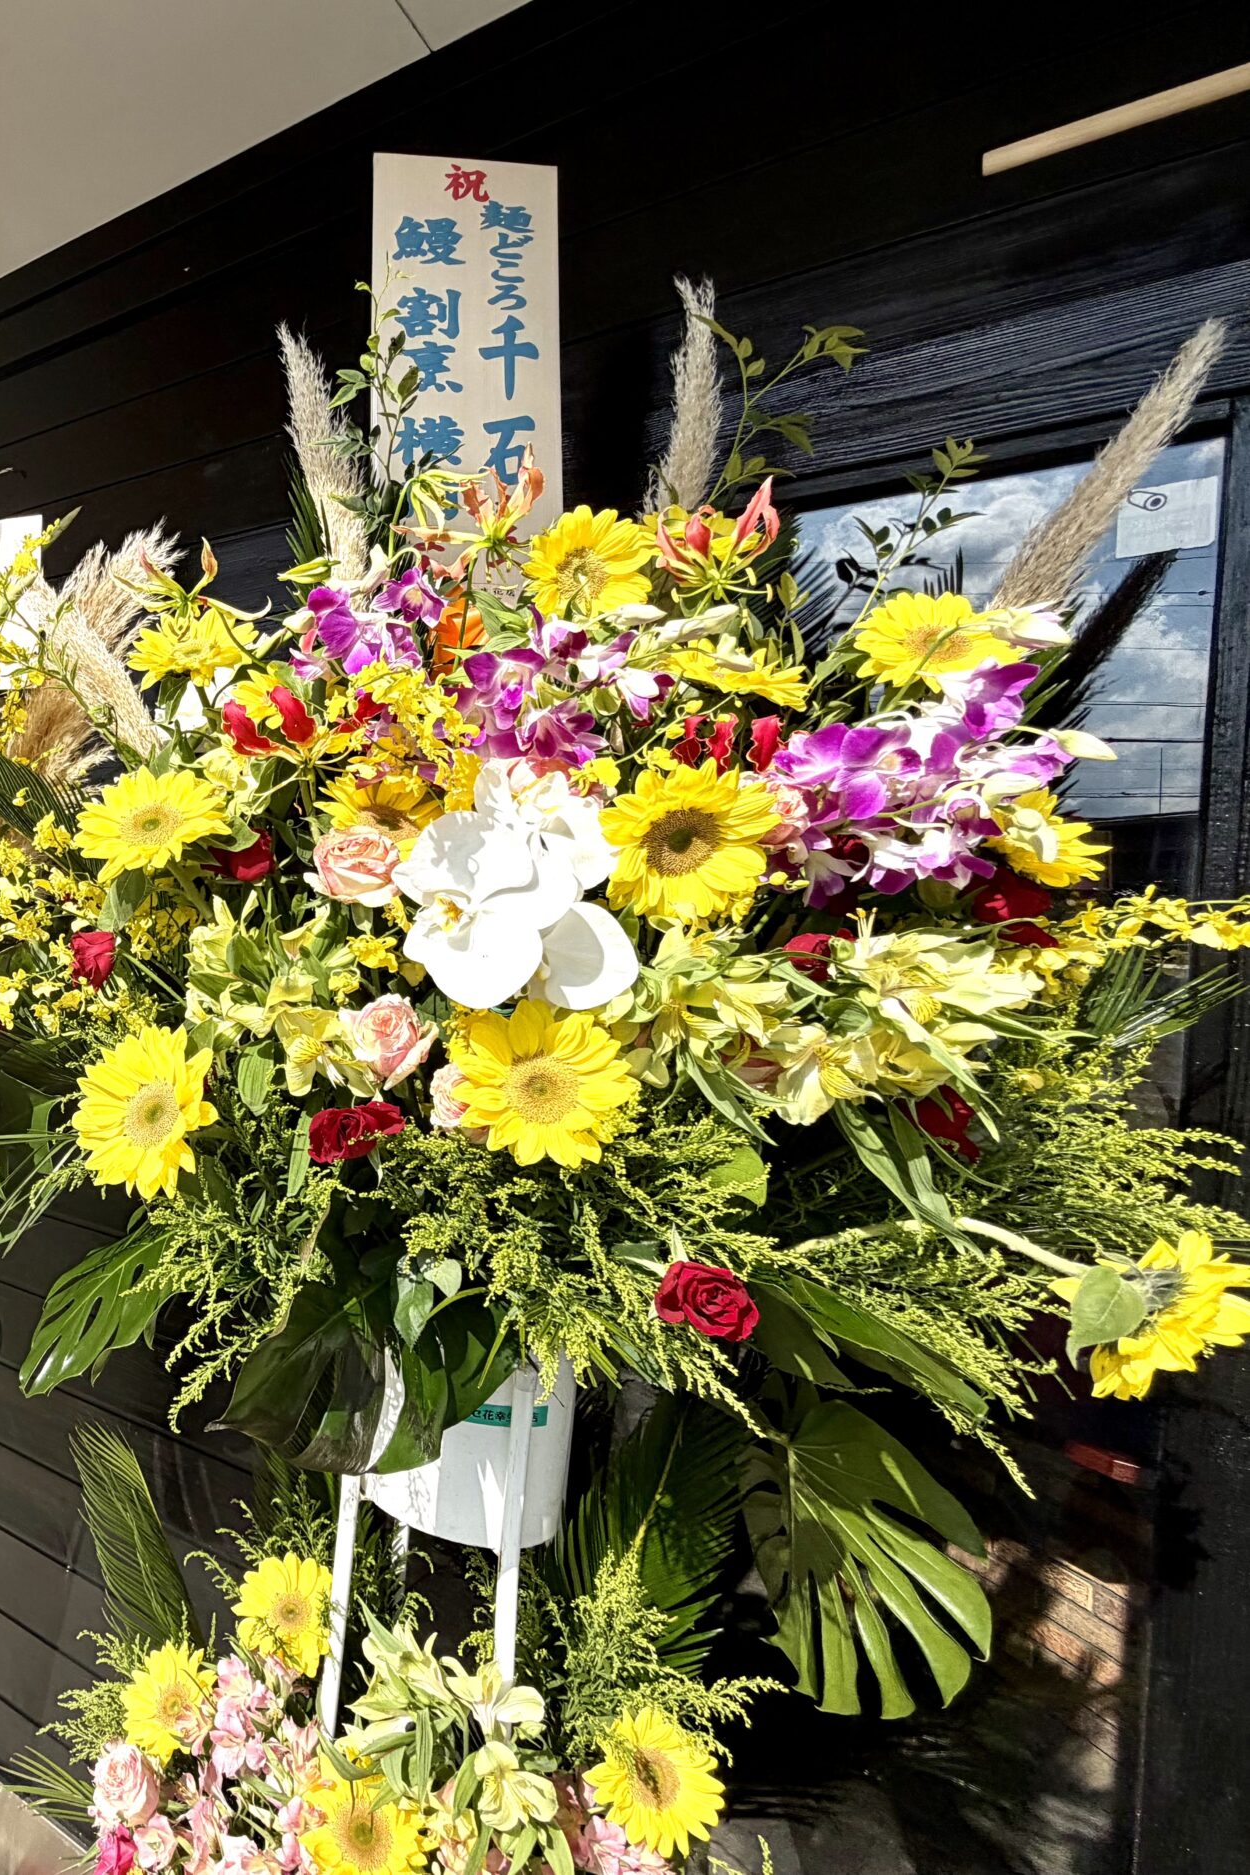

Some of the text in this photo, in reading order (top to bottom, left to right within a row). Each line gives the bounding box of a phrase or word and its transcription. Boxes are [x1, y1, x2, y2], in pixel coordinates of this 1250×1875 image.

[444, 163, 490, 203] 祝
[392, 215, 467, 520] 鰻割烹横
